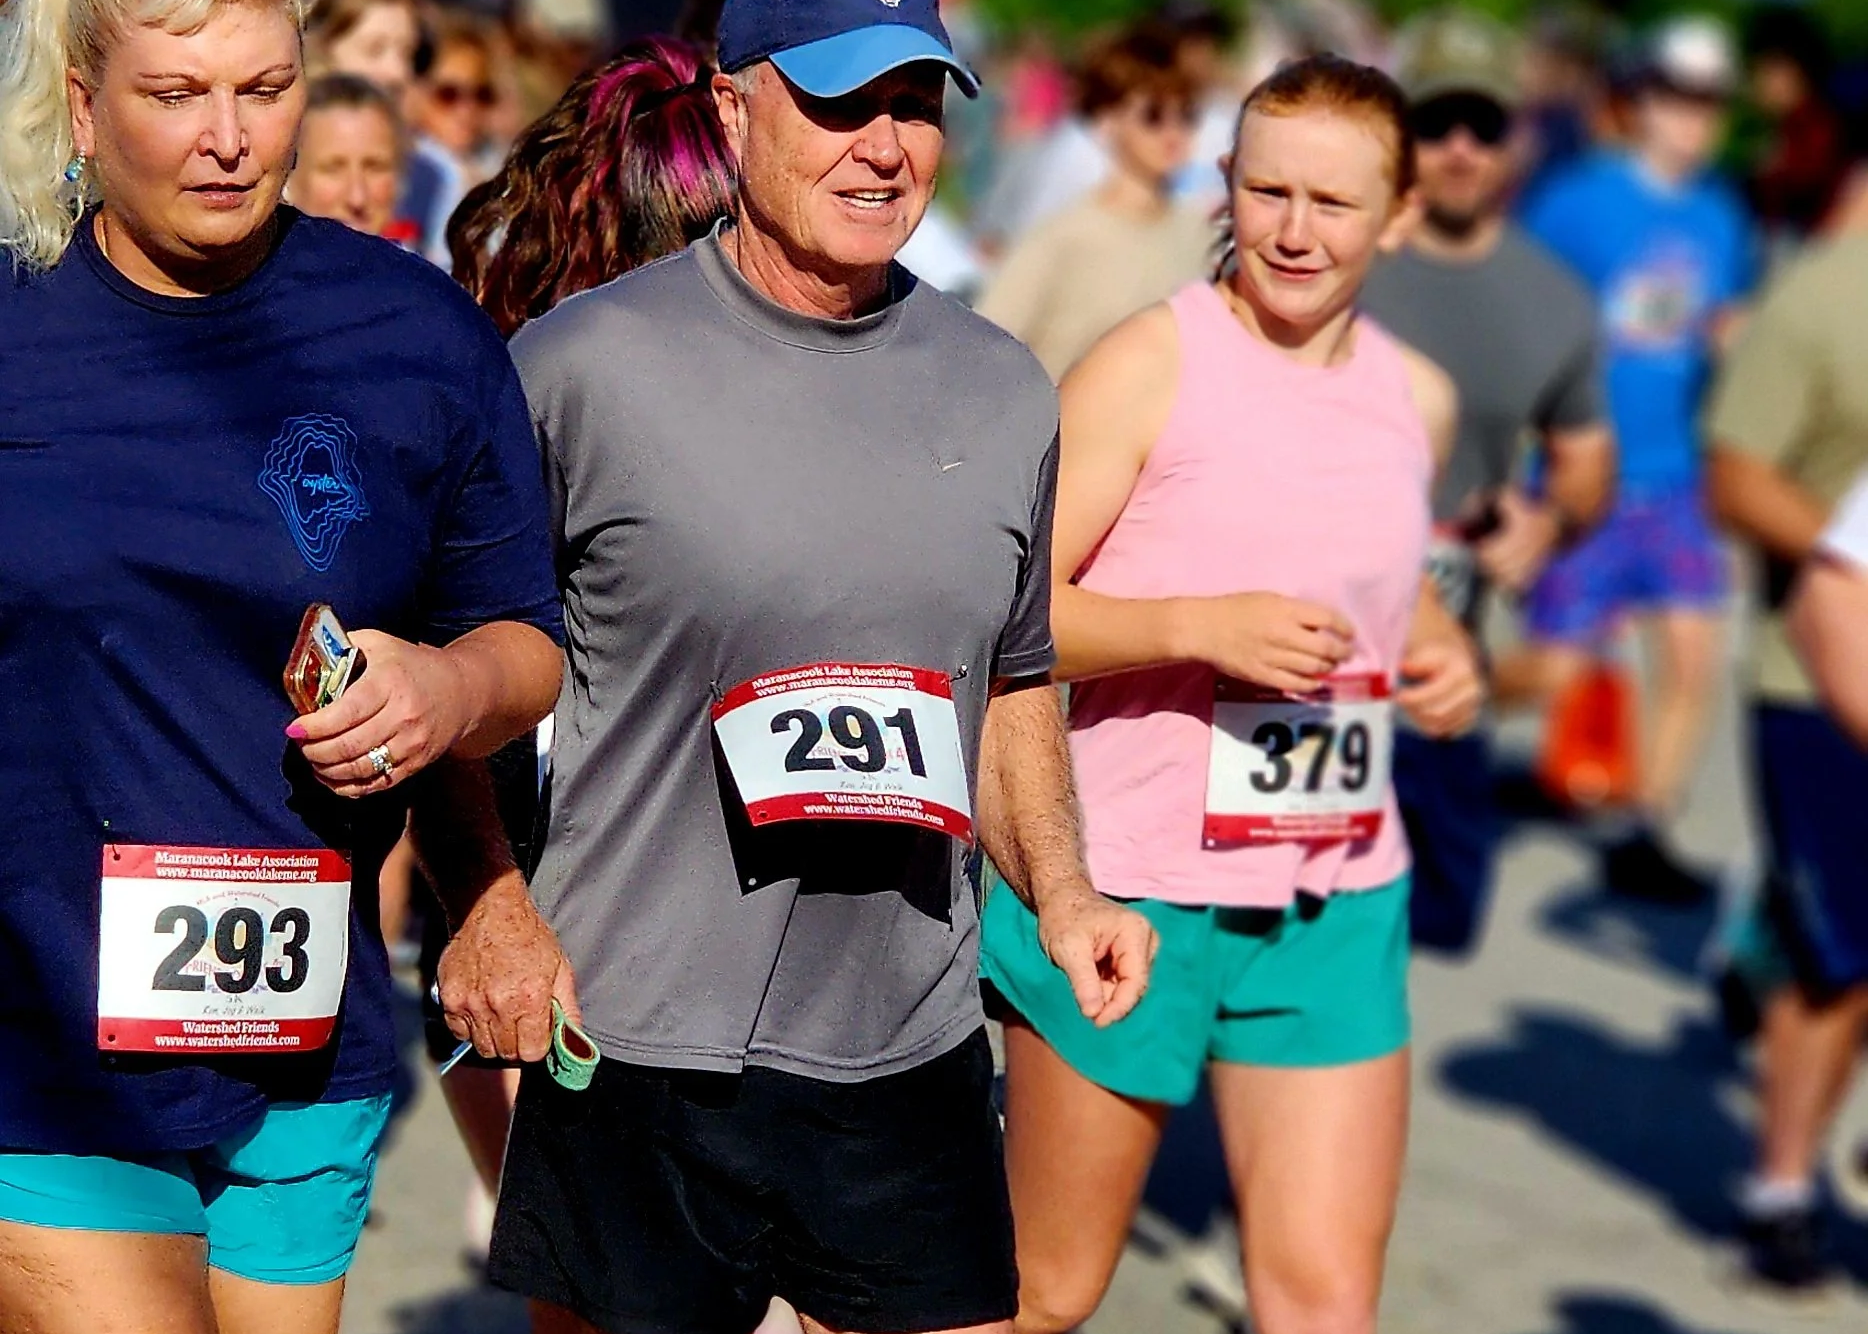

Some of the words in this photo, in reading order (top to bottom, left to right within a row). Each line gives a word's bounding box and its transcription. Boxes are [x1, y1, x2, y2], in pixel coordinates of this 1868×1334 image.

[752, 667, 824, 689] Maranacook
[824, 666, 851, 677] Lake
[852, 667, 914, 680] Association
[770, 706, 927, 778] 291
[1250, 721, 1371, 794] 379
[824, 793, 884, 806] Watershed
[884, 796, 924, 810] Friends
[803, 804, 945, 826] www.watershedfriends.com
[154, 851, 232, 866] Maranacook
[233, 854, 261, 866] Lake
[261, 854, 319, 868] Association
[155, 866, 318, 882] www.maranacooklakeme.org
[151, 905, 311, 994] 293
[182, 1021, 241, 1034] Watershed
[241, 1021, 280, 1034] Friends
[154, 1034, 301, 1048] www.watershedfriends.com
